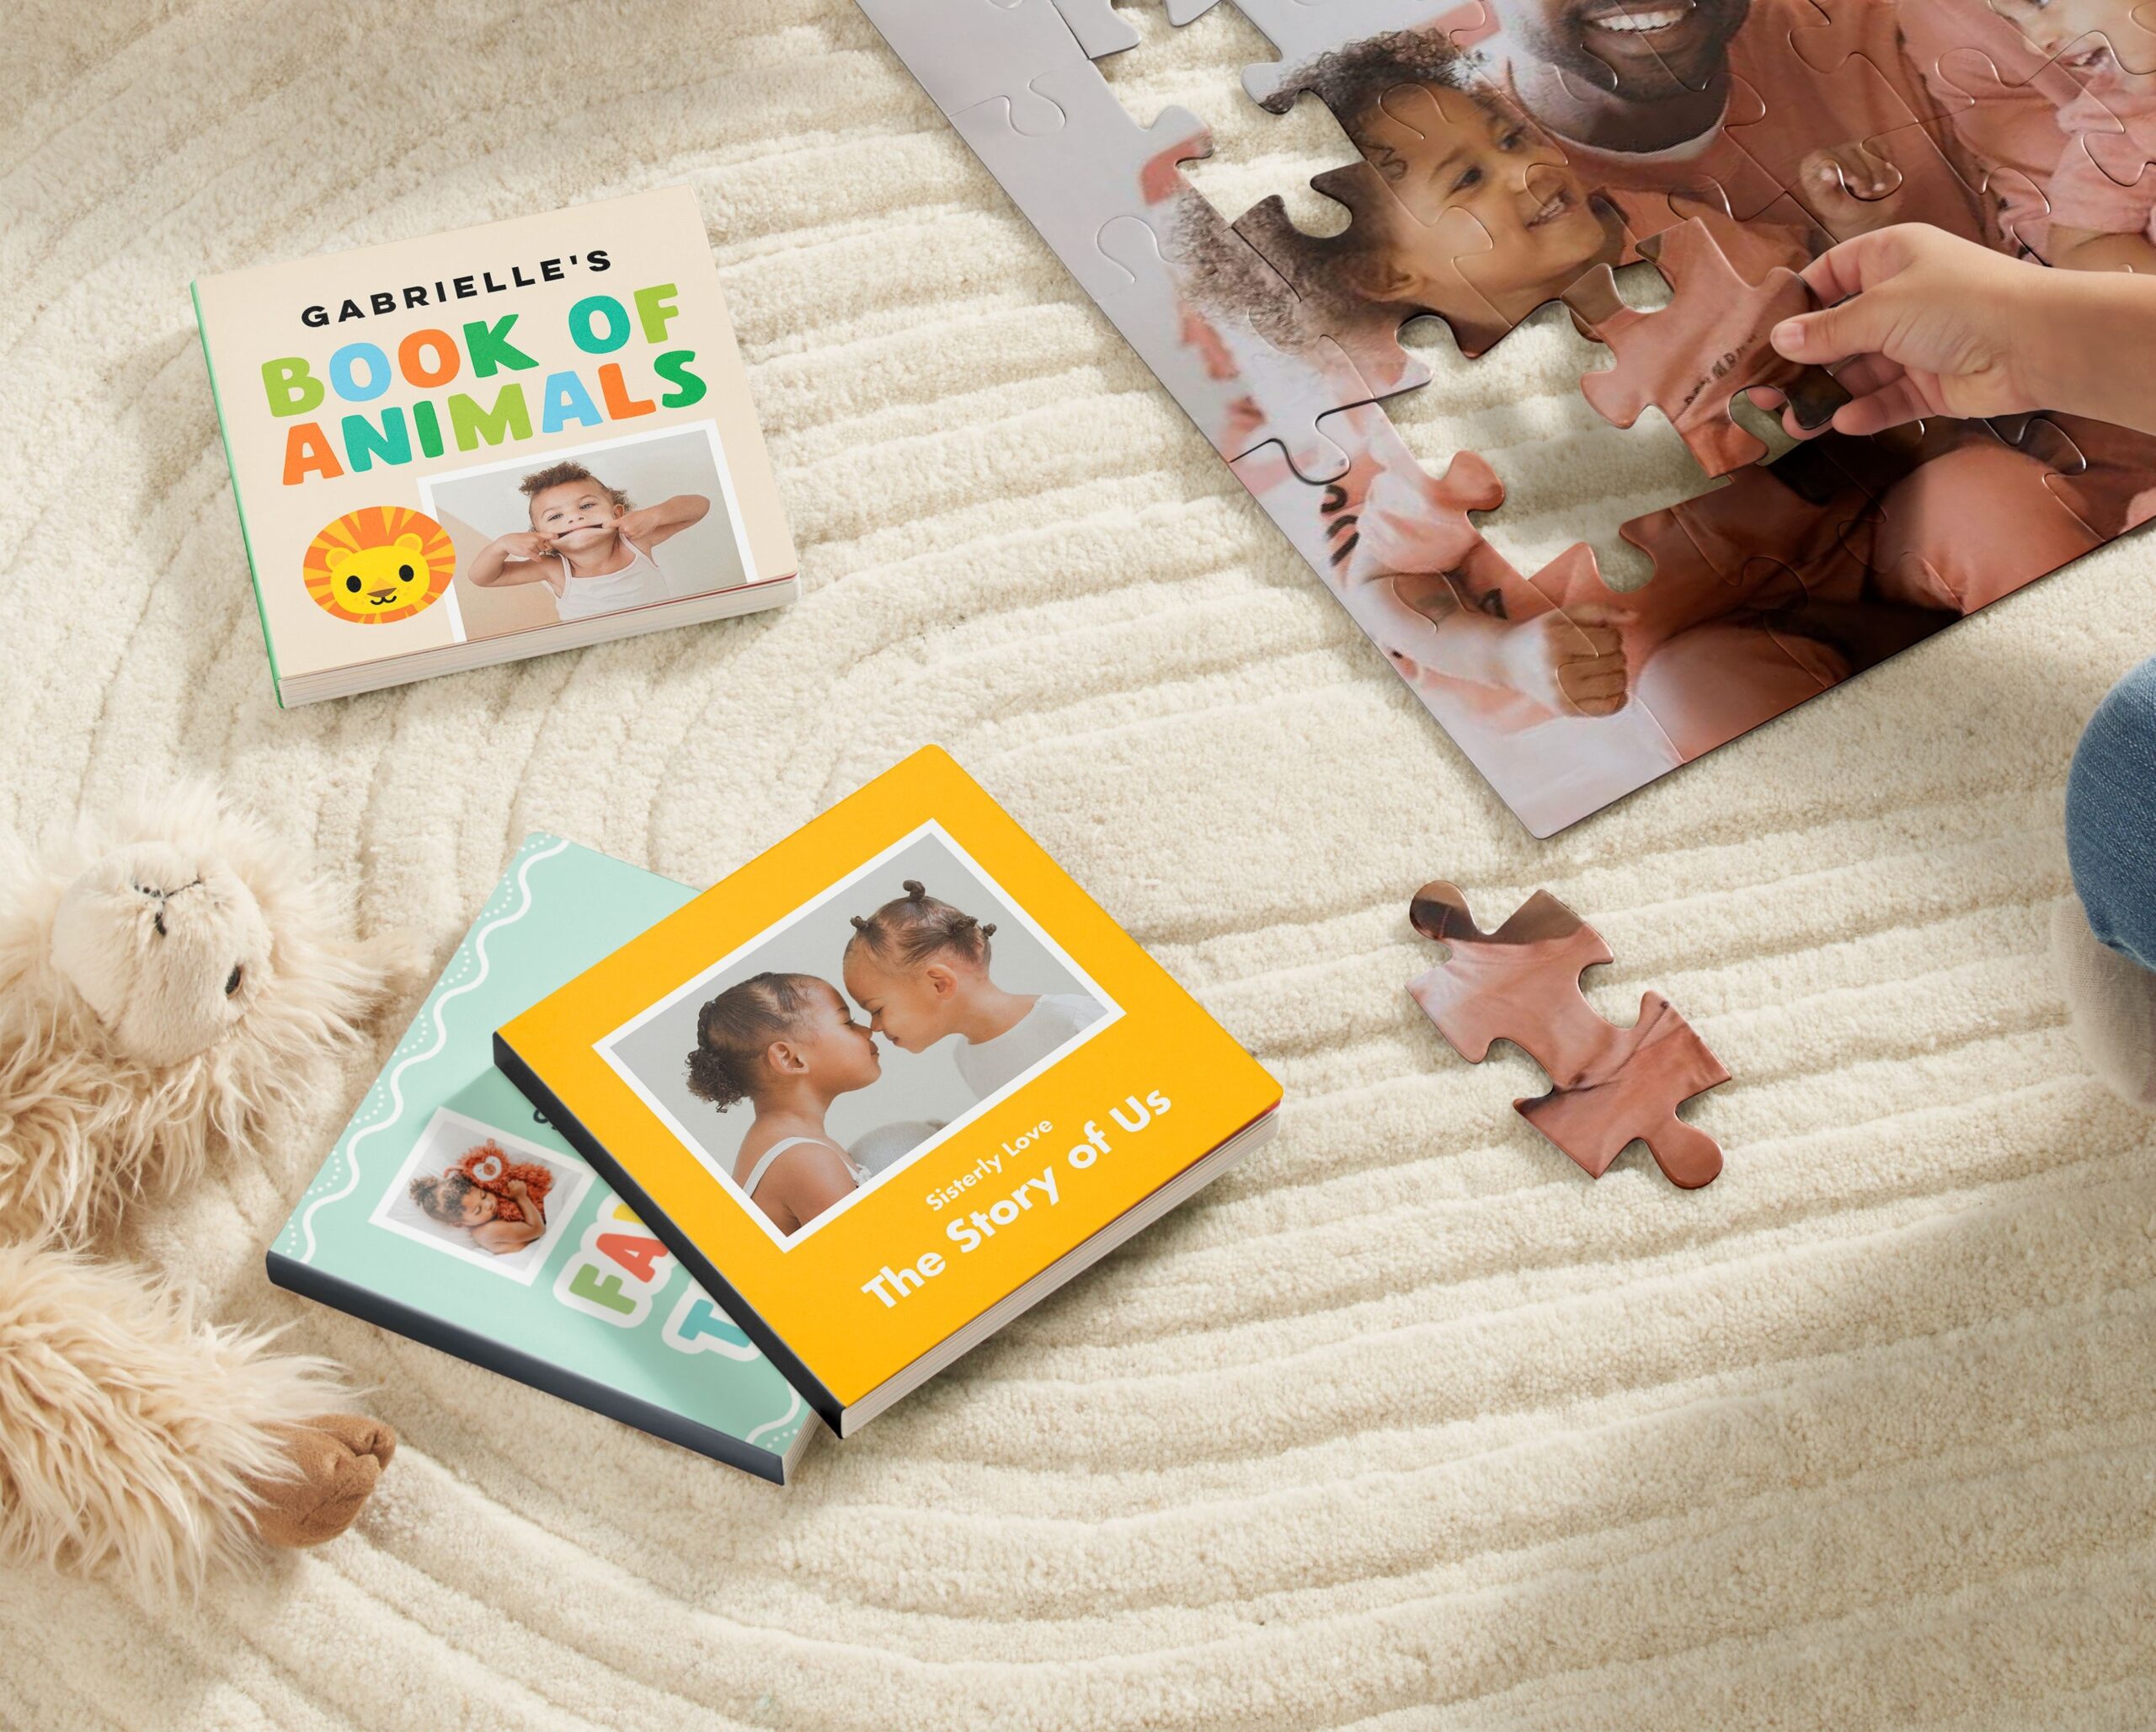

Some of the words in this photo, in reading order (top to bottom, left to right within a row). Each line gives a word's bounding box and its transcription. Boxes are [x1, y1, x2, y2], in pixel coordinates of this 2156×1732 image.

[261, 313, 540, 418] BOOK
[568, 283, 680, 355] OF
[302, 250, 611, 328] GABRIELLE'S
[281, 350, 707, 486] ANIMALS
[860, 1251, 946, 1308] The
[946, 1165, 1060, 1254] Story
[1067, 1119, 1113, 1169] of
[1108, 1089, 1171, 1133] Us
[926, 1153, 1004, 1211] Sisterly
[1001, 1119, 1054, 1157] Love
[568, 1203, 671, 1316] FA
